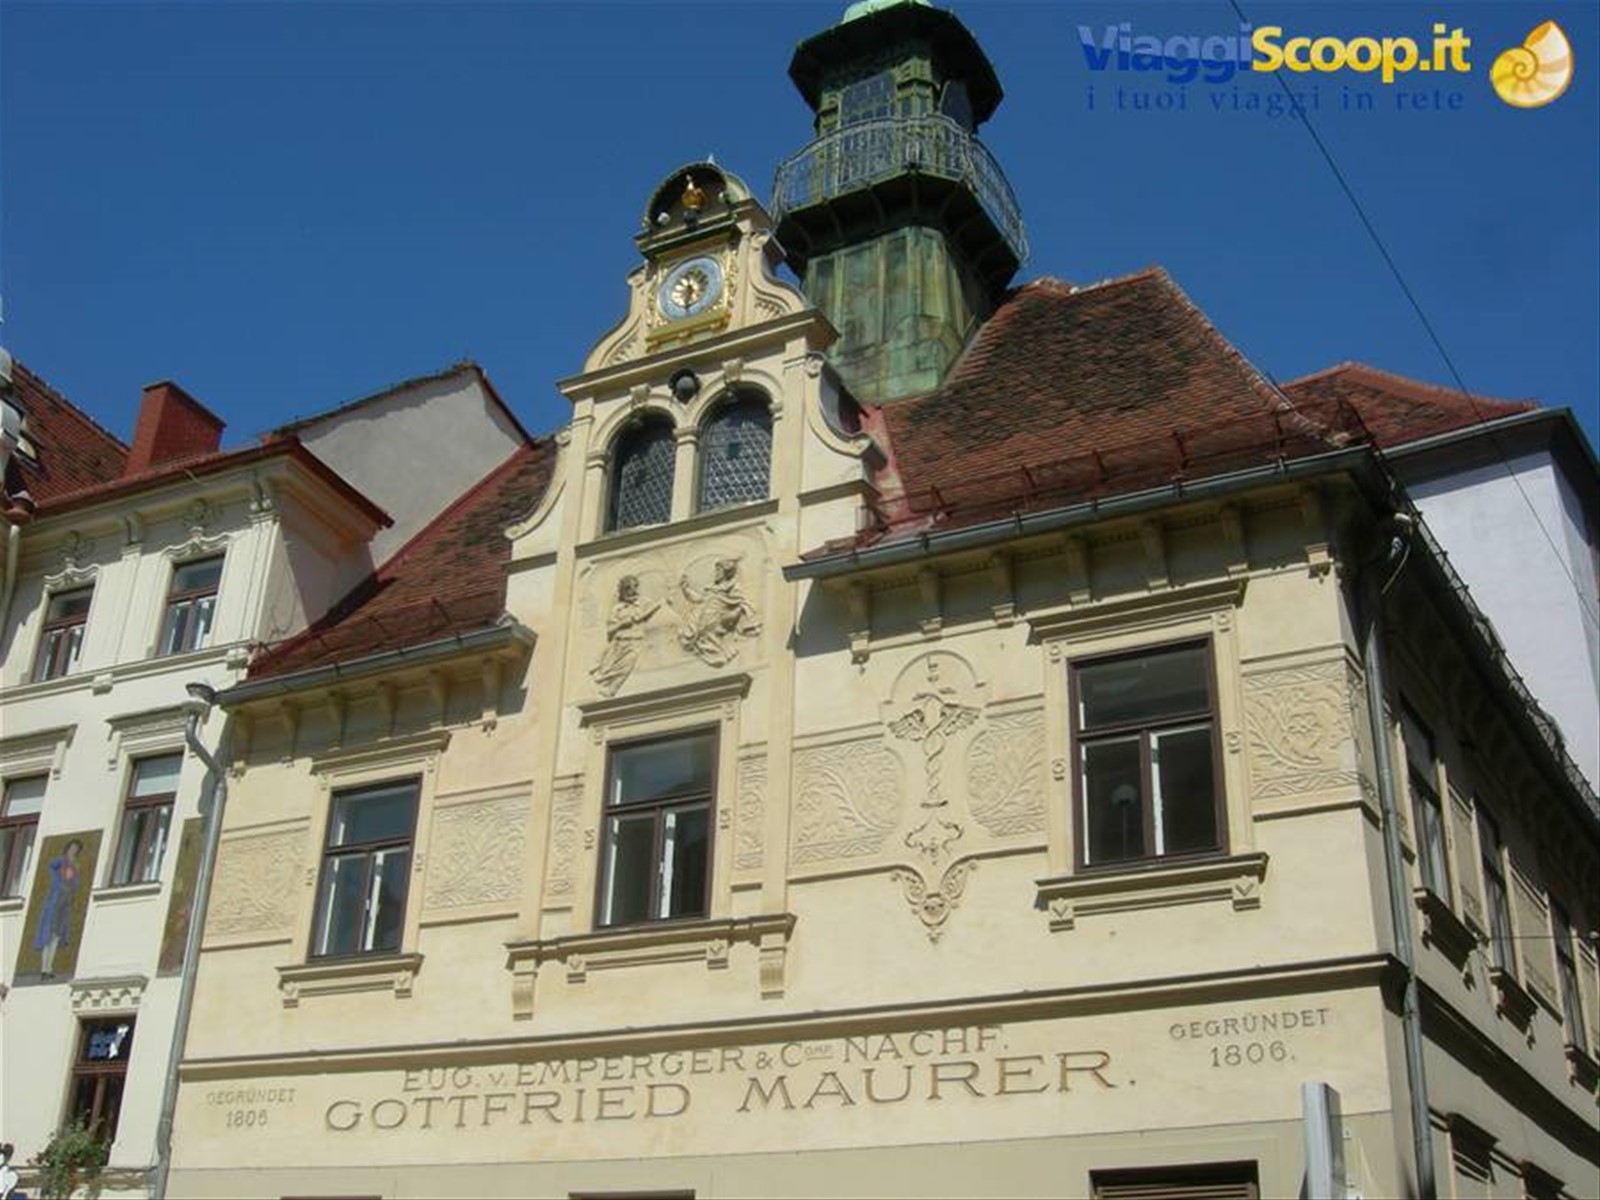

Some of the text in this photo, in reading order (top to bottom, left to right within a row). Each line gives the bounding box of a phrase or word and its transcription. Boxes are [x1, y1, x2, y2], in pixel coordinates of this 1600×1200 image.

[1169, 1007, 1329, 1041] GEGRÜNDET
[517, 1047, 746, 1086] EMPERGER
[844, 1026, 1009, 1063] NACHF.
[325, 1050, 1137, 1131] GOTTFRIED MAURER.
